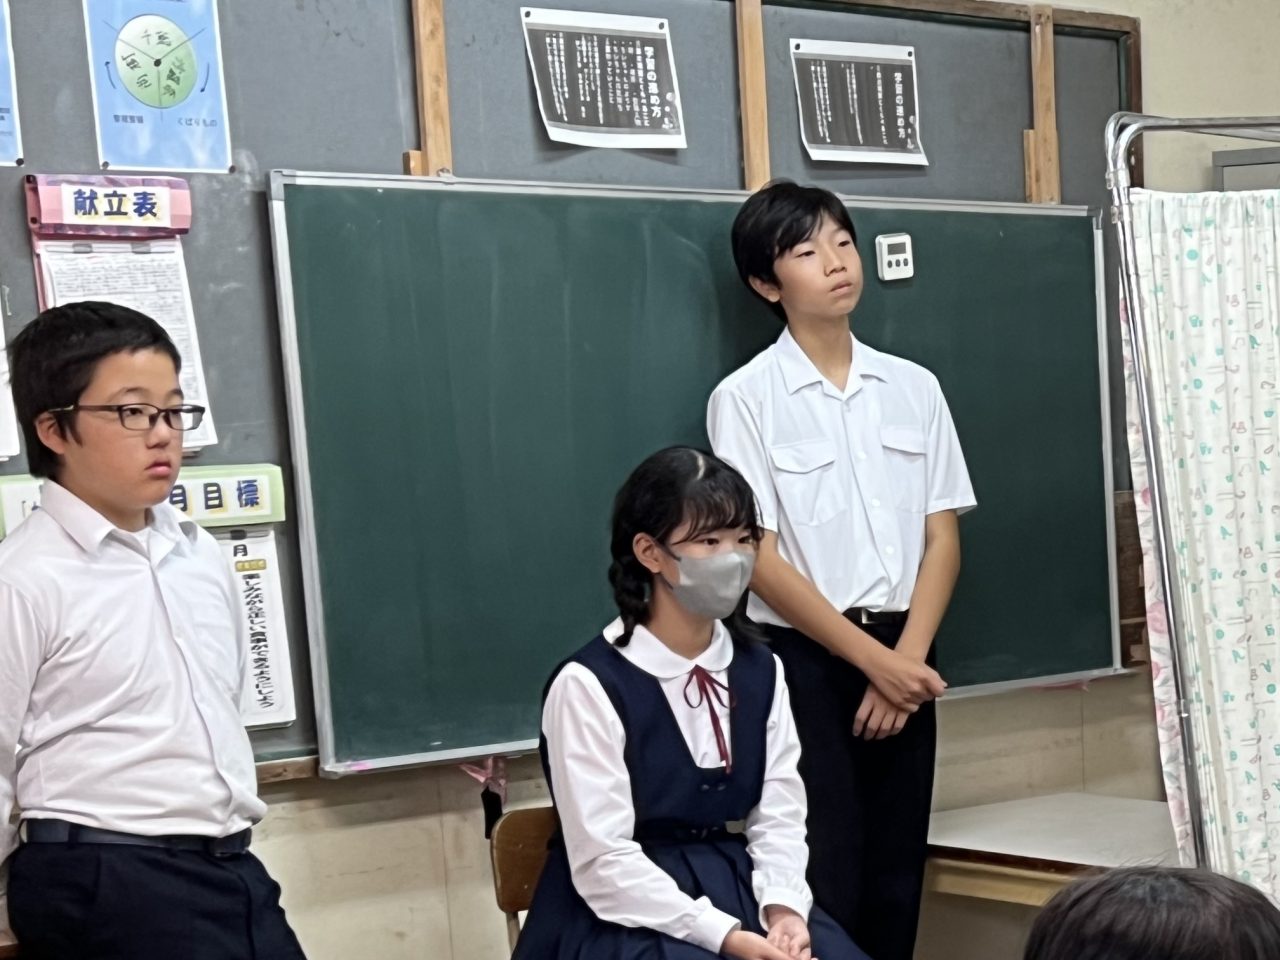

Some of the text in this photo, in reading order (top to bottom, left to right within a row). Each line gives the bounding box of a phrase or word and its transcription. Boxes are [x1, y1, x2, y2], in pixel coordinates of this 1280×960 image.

[177, 117, 218, 127] くばりもの
[73, 189, 159, 218] 献立表
